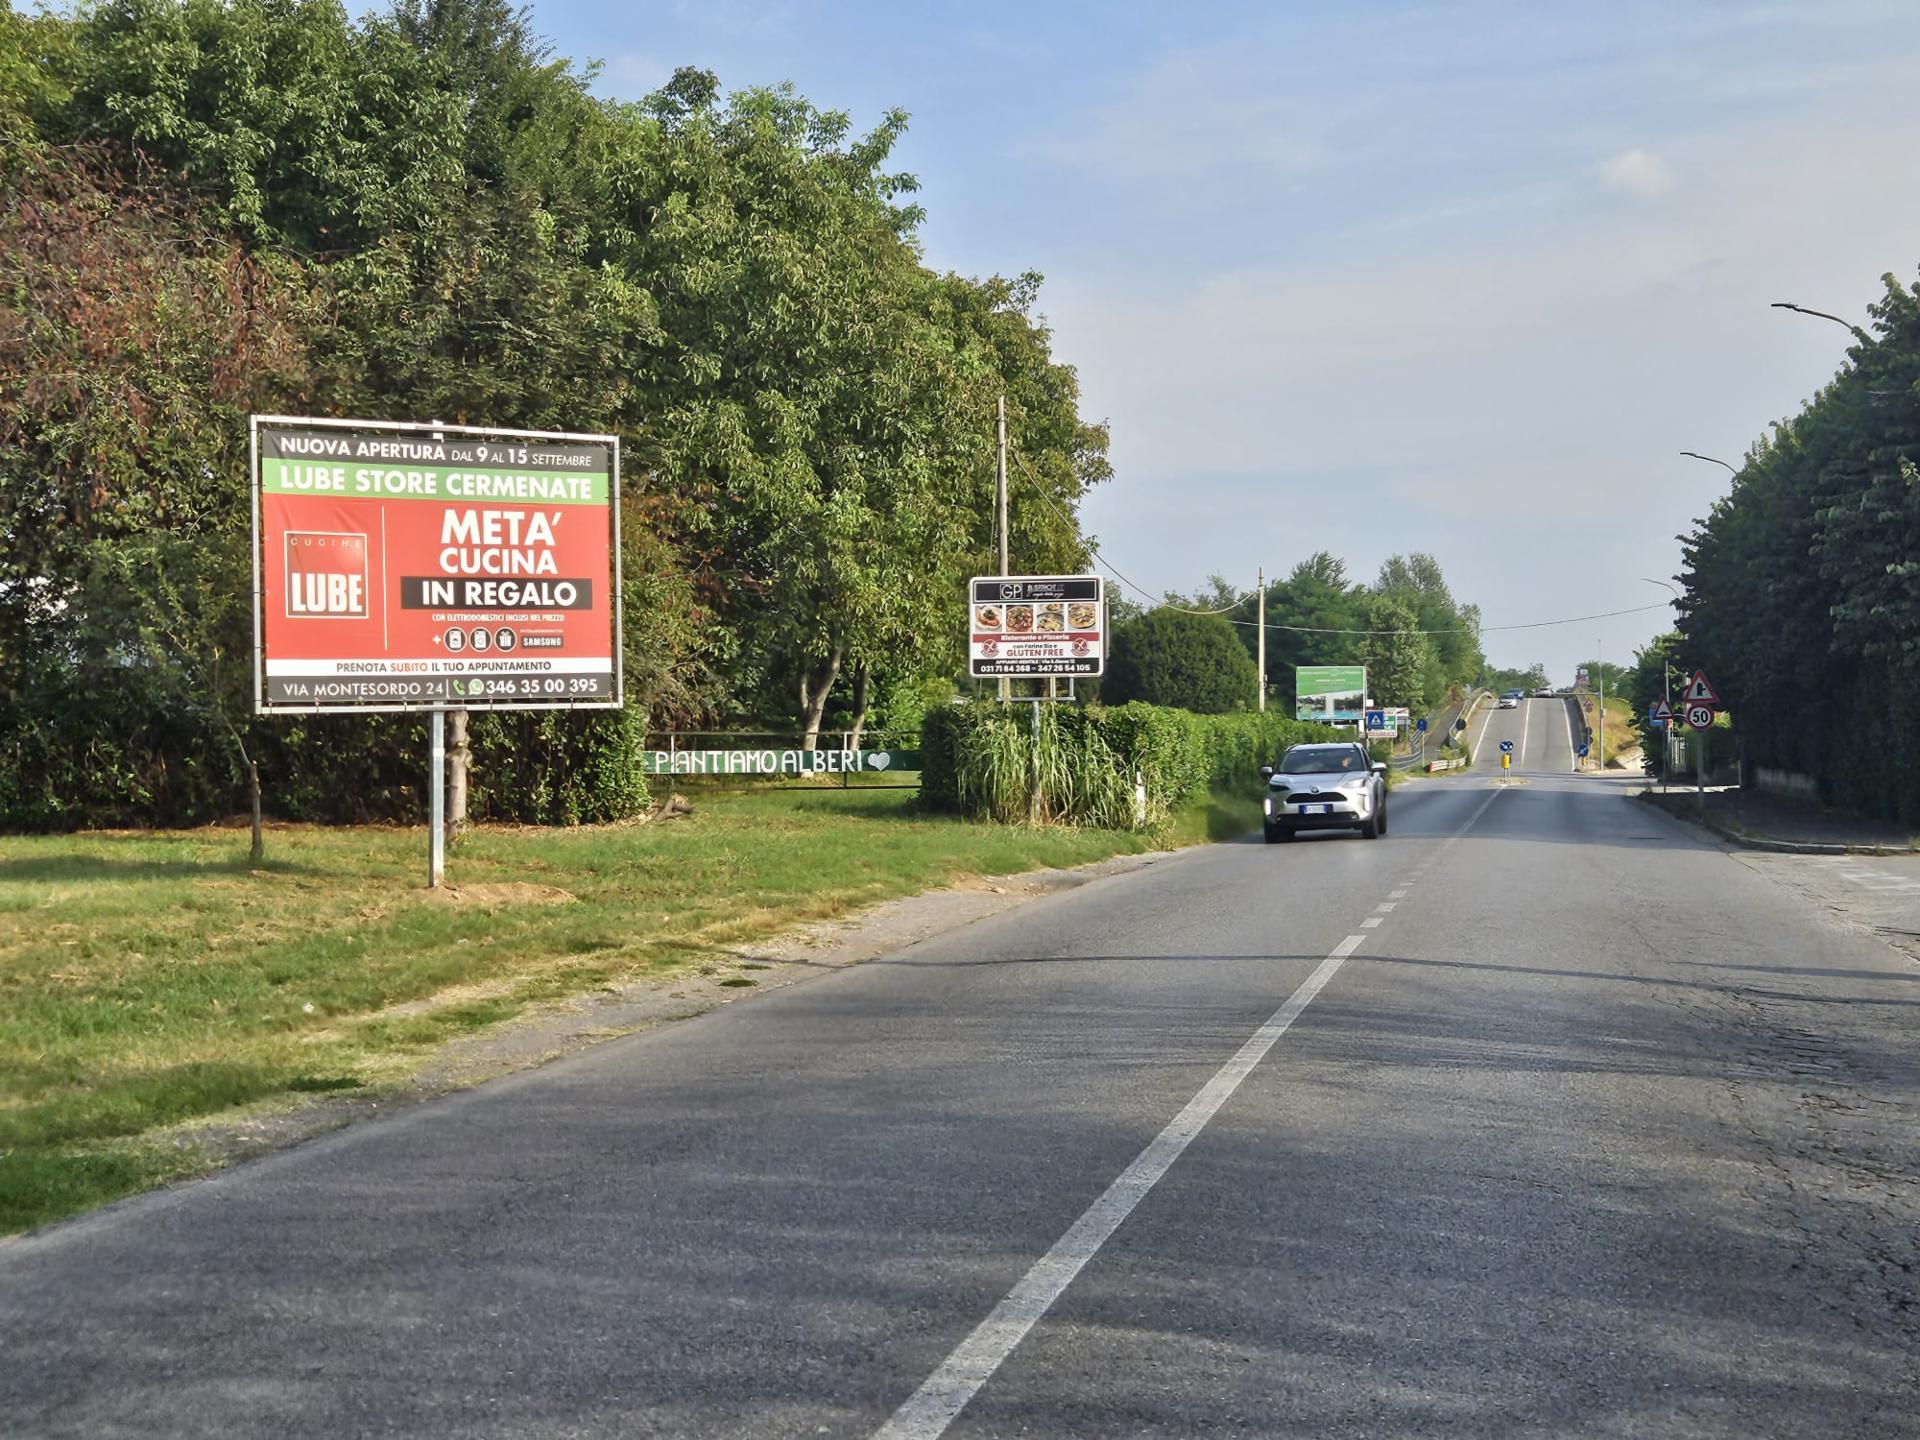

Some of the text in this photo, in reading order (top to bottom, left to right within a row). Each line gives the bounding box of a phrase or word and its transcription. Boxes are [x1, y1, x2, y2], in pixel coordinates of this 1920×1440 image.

[281, 438, 592, 466] NUOVA APERTURA DAL 9 AL 15 SETTEMBRE
[281, 465, 592, 499] LUBE STORE CERMENATE
[290, 537, 361, 548] CUCINE
[439, 548, 558, 574] CUCINA
[291, 573, 362, 612] LUBE
[422, 581, 577, 606] IN REGALO
[1001, 585, 1022, 599] GP
[523, 637, 562, 646] SAMSUNG
[1007, 649, 1042, 657] GLUTEN
[336, 661, 552, 673] PRENOTA SUBITO IL TUO APPUNTAMENTO
[284, 678, 598, 696] VIA MONTESORDO 24 346 35 00 395
[1692, 710, 1709, 724] 50
[655, 750, 862, 773] PIANTIAMO ALBERI
